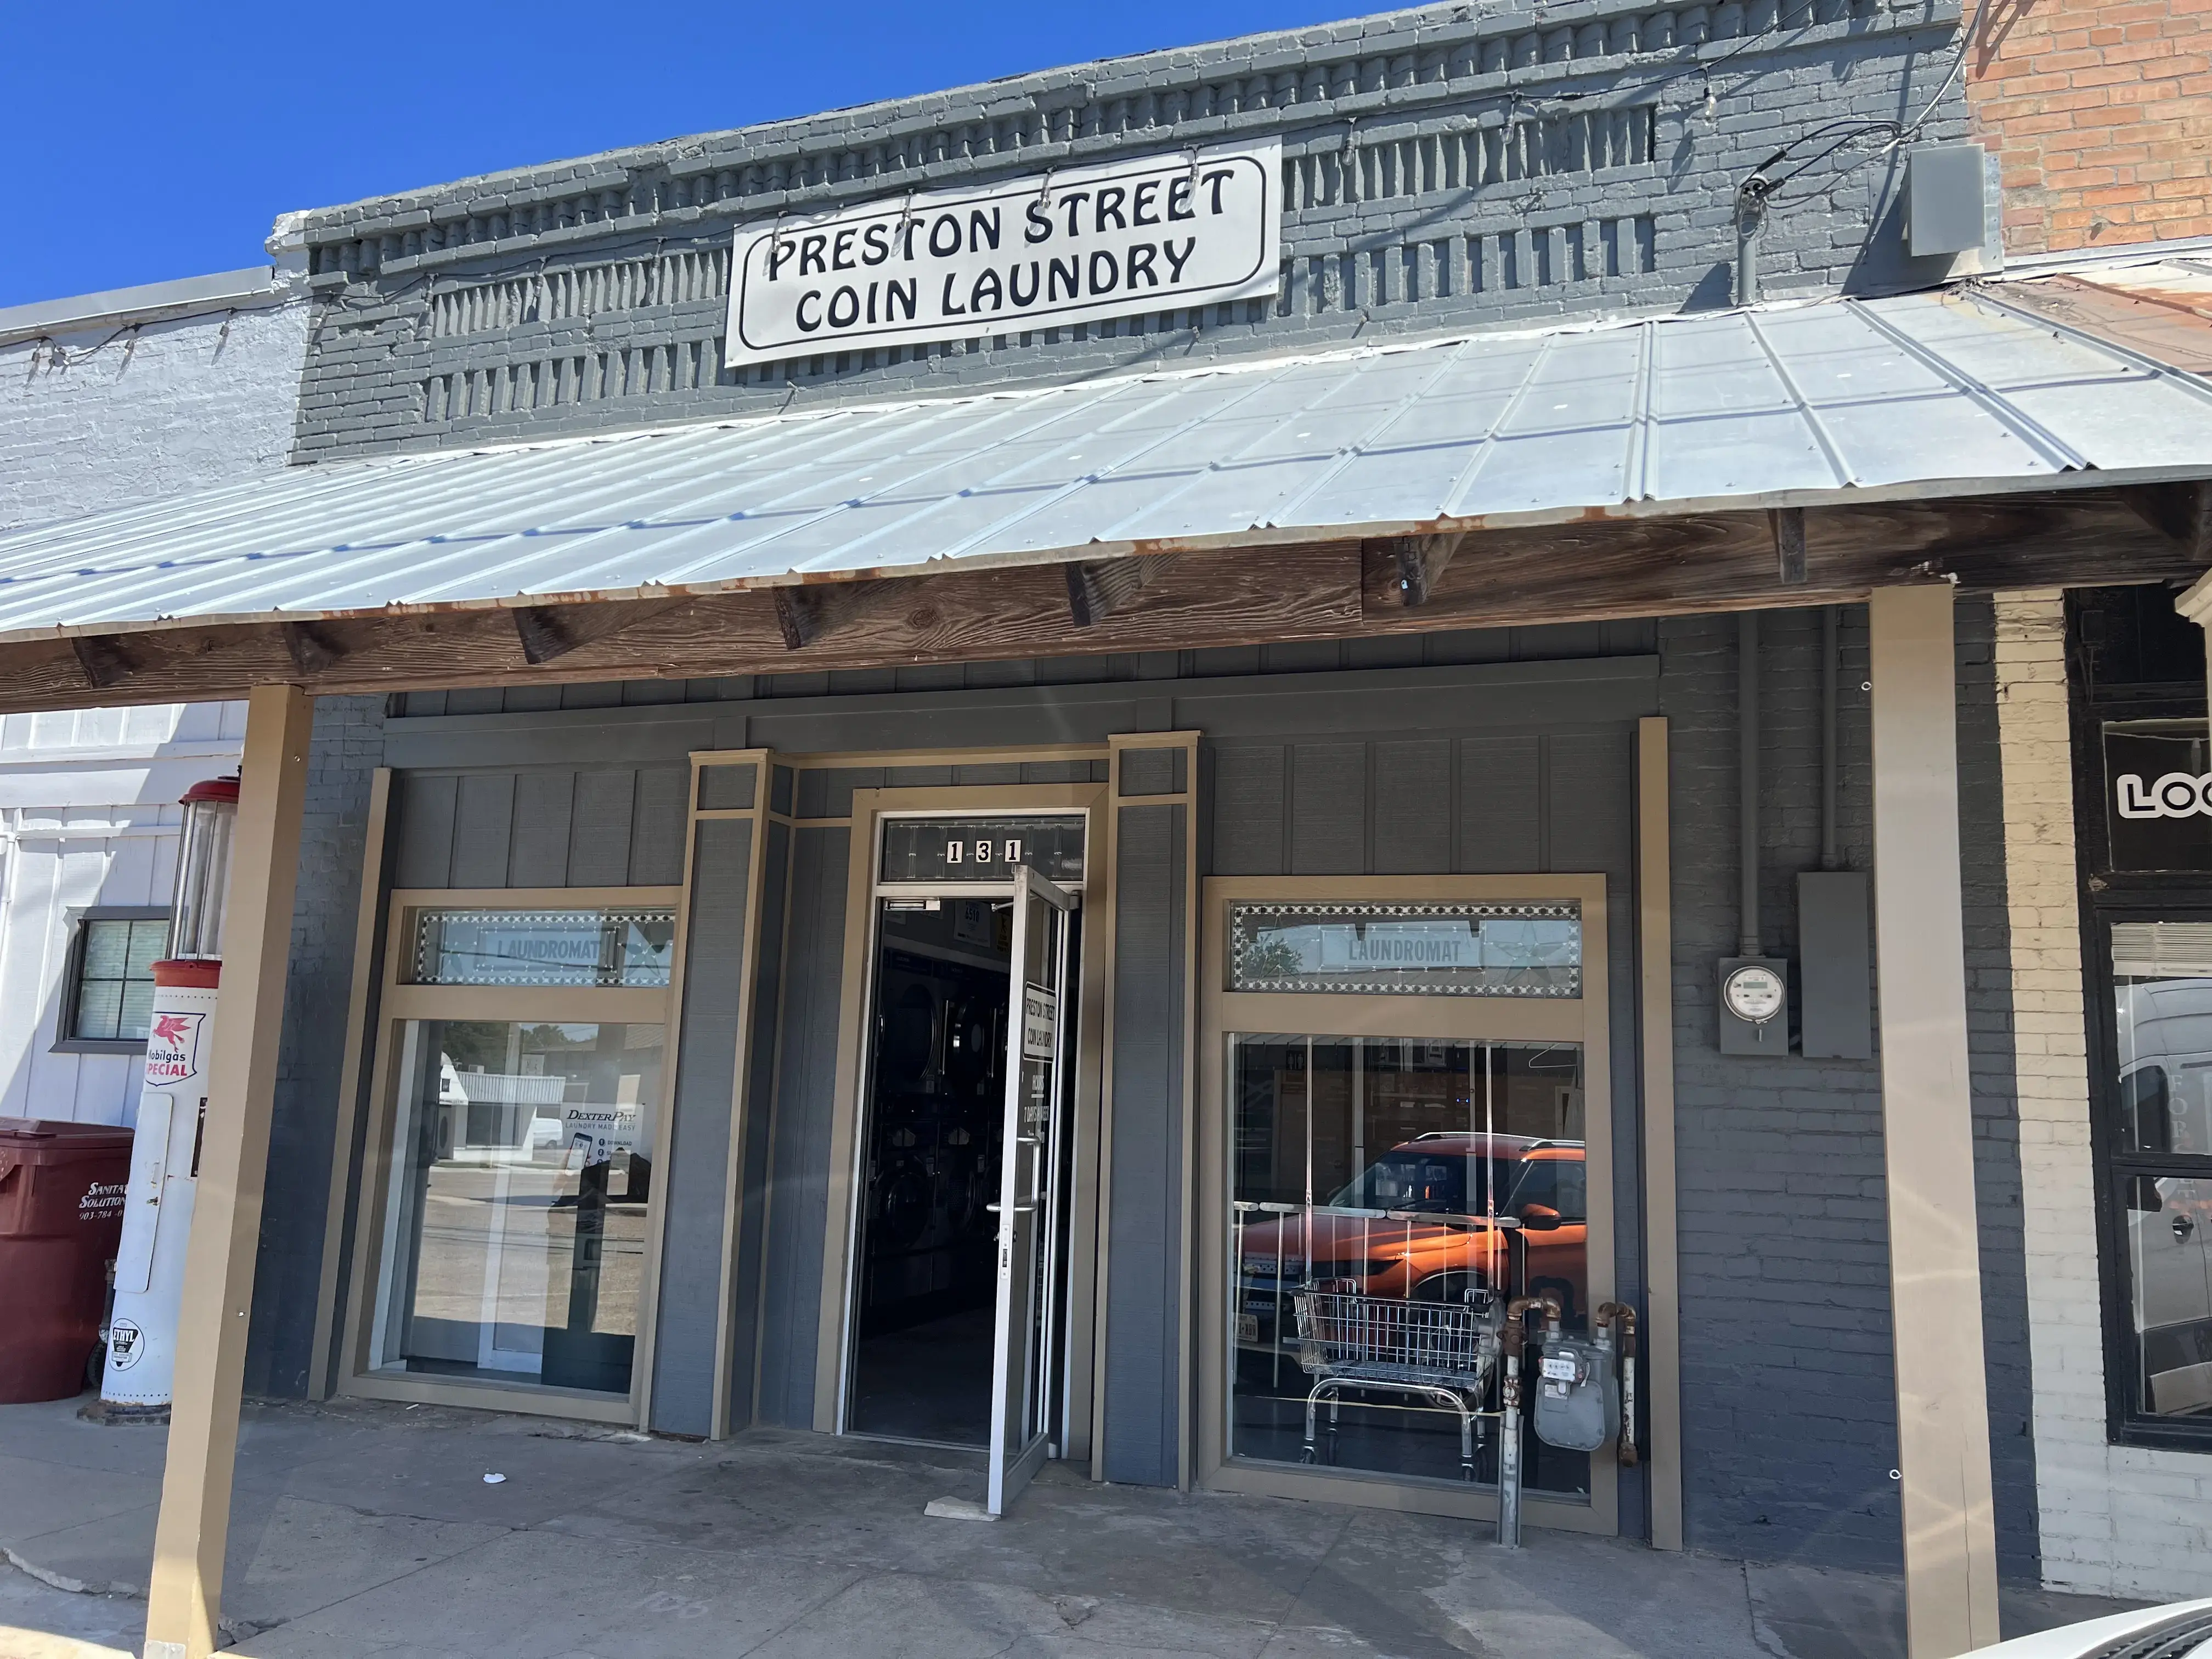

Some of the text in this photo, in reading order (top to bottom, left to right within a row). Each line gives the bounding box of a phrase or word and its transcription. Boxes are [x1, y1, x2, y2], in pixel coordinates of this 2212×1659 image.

[770, 170, 1234, 281] PRESTON STREET
[797, 238, 1196, 331] COIN LAUNDRY
[951, 842, 1016, 861] 131
[497, 940, 599, 959] LAUNDROMAT
[1349, 940, 1461, 962] LAUNDROMAT
[1026, 997, 1042, 1018] PRESTON
[1028, 1027, 1036, 1045] COIN
[147, 1063, 187, 1076] PECIAL
[113, 1329, 134, 1342] ETHYL
